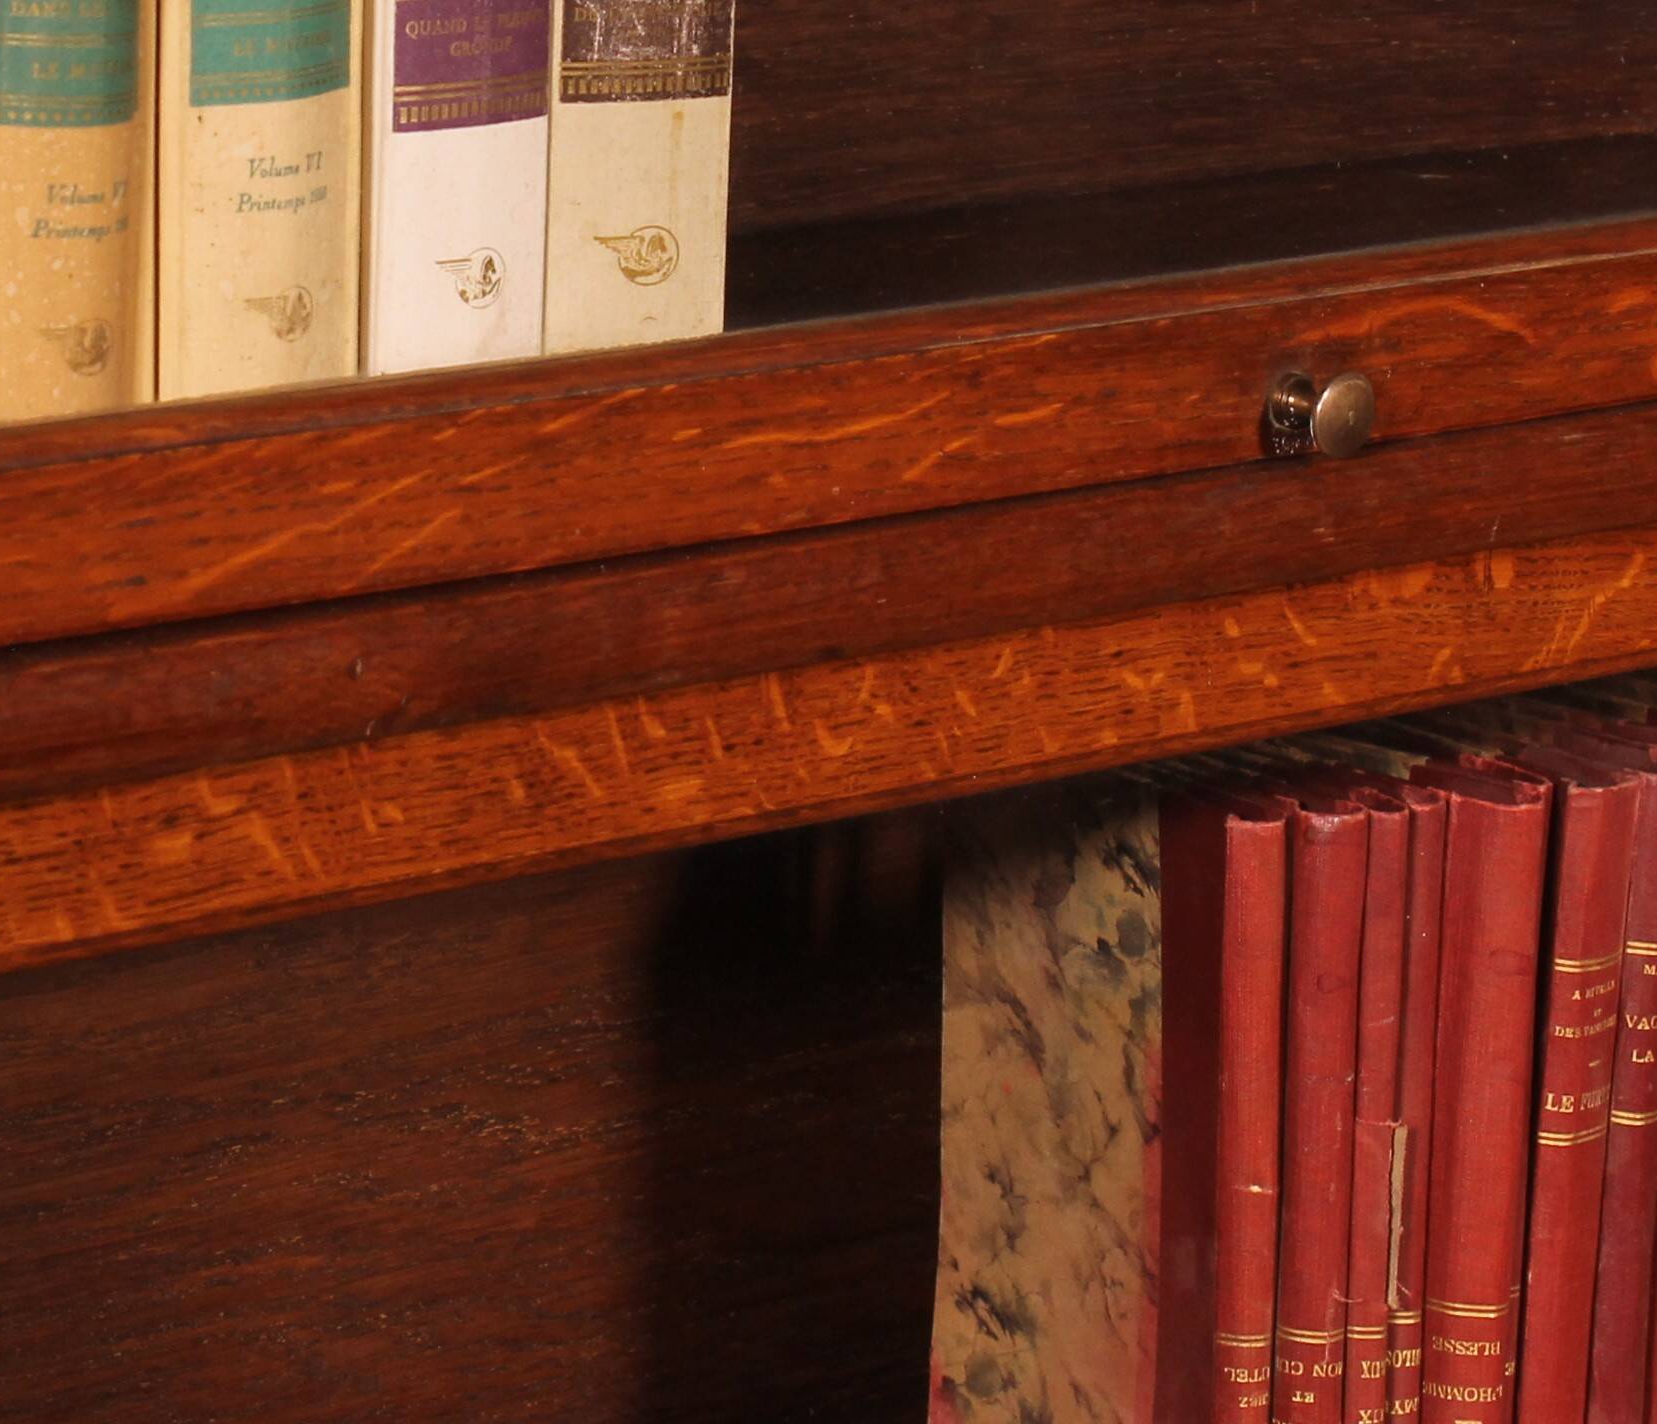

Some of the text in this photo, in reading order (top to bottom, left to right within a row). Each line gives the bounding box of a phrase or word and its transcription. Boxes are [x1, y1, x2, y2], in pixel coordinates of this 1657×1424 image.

[405, 18, 468, 40] QUAND
[248, 156, 300, 179] Volume
[236, 192, 306, 214] Printemps
[1631, 1049, 1655, 1063] LA
[1544, 1092, 1575, 1114] LE
[1224, 1366, 1271, 1383] UTEL
[1292, 1390, 1315, 1404] ET
